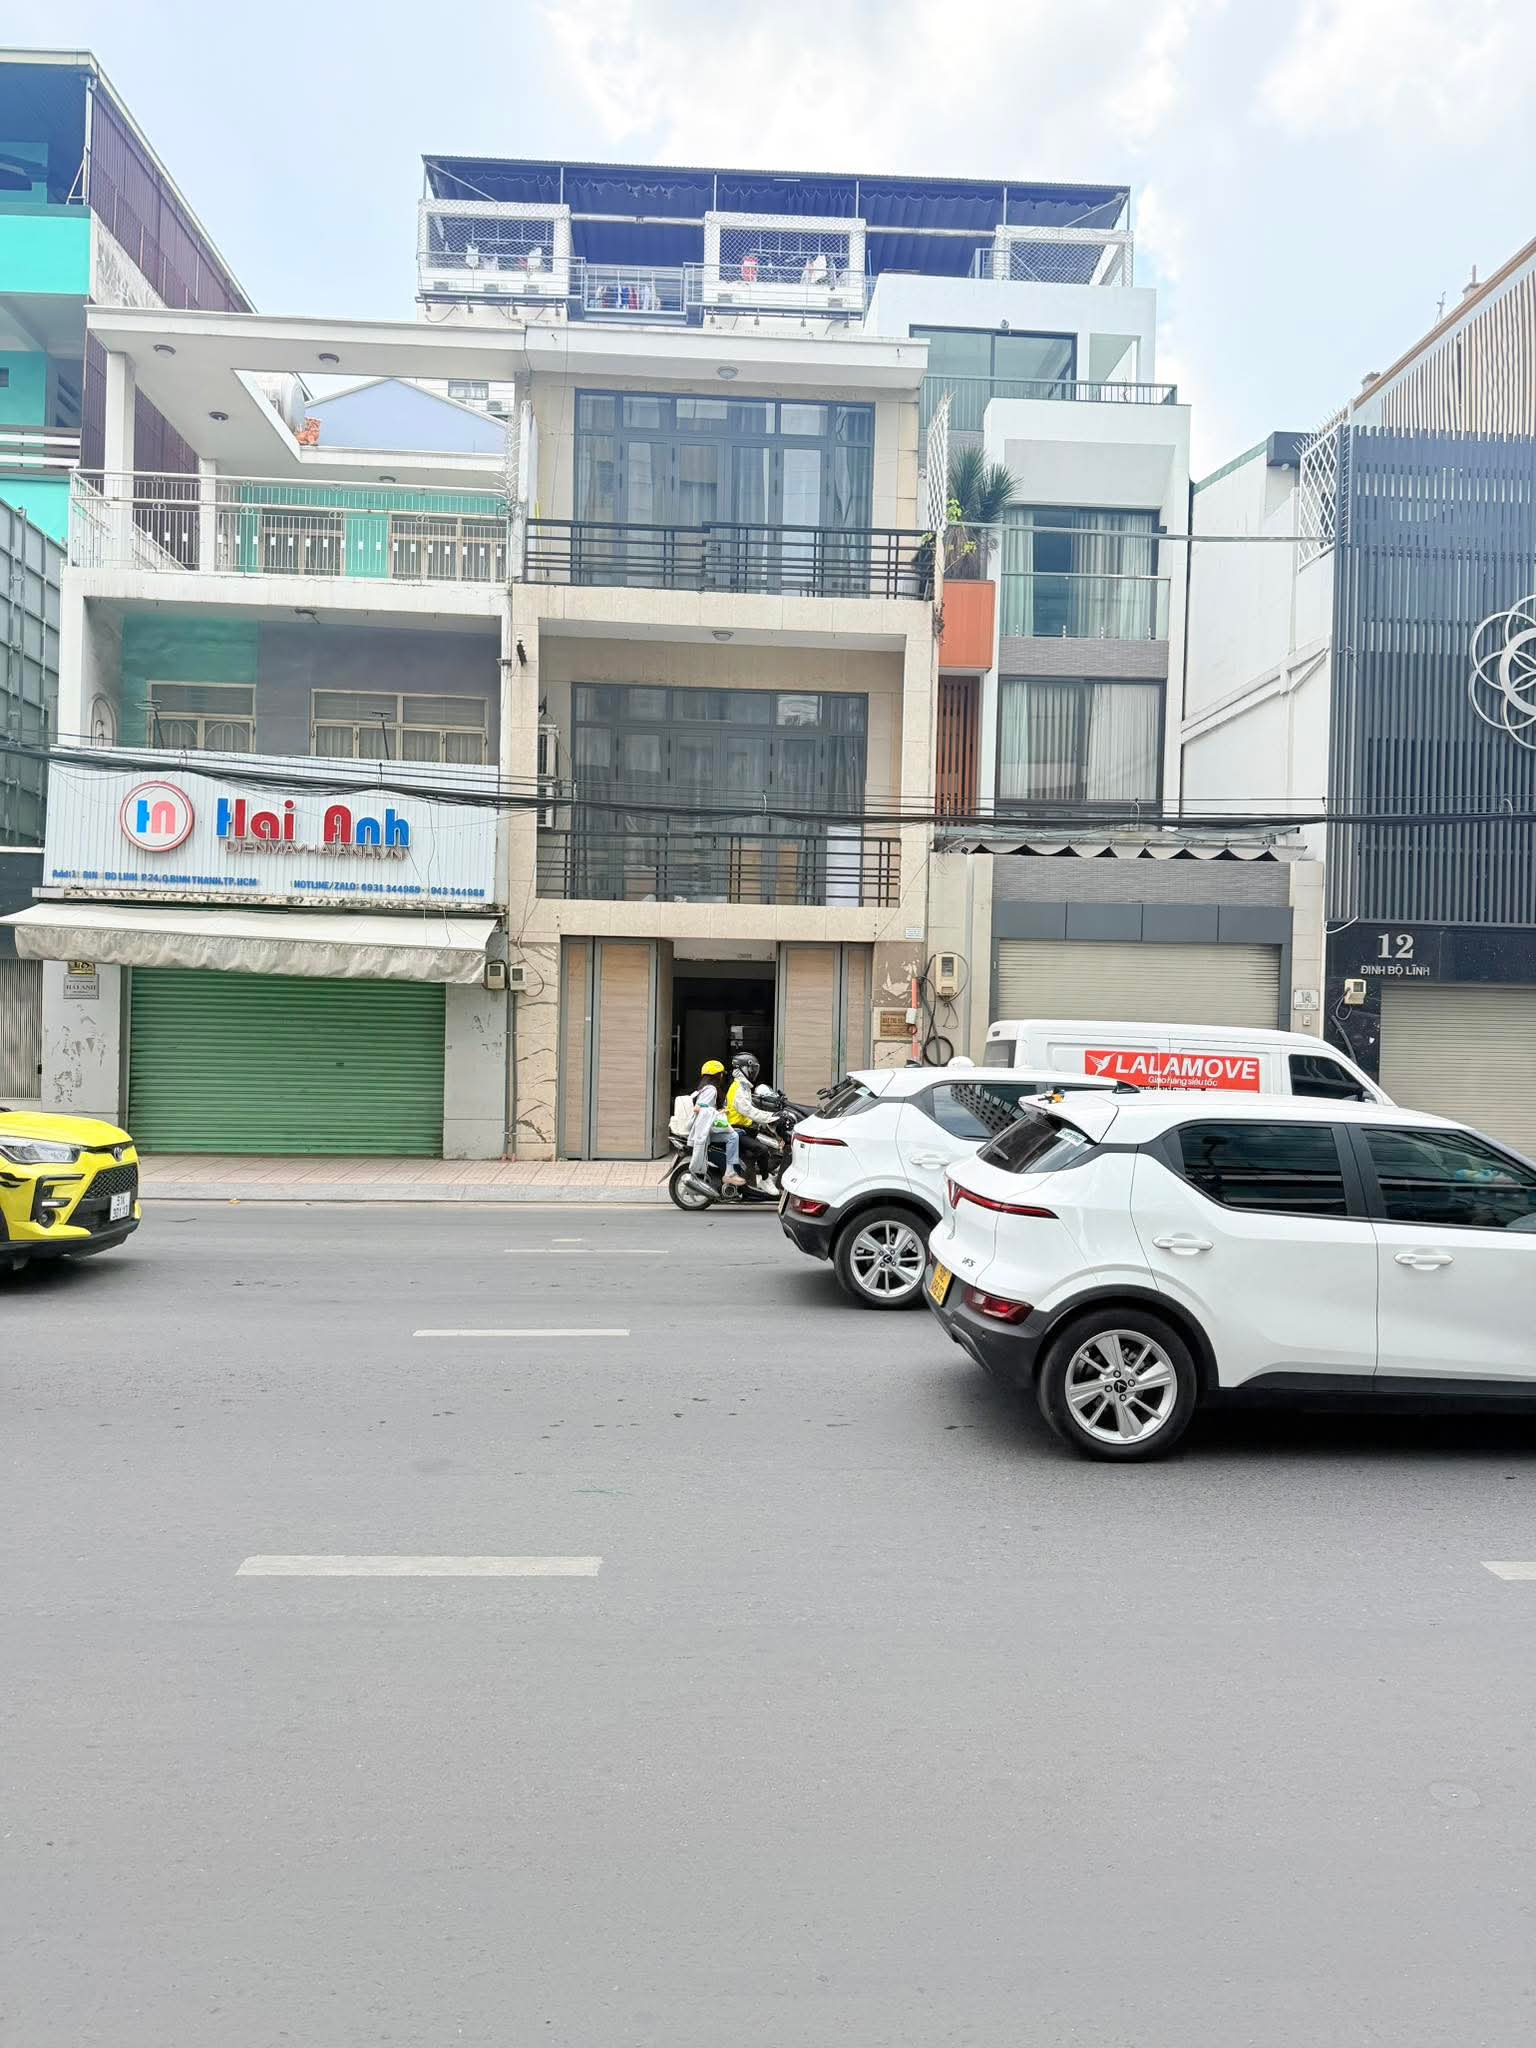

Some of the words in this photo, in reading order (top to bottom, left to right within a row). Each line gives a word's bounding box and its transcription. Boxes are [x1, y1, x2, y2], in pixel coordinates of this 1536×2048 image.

[216, 797, 297, 841] Hai
[323, 803, 411, 848] Anh
[1377, 933, 1415, 960] 12
[1360, 965, 1386, 976] ĐINH
[1115, 1054, 1258, 1080] LALAMOVE
